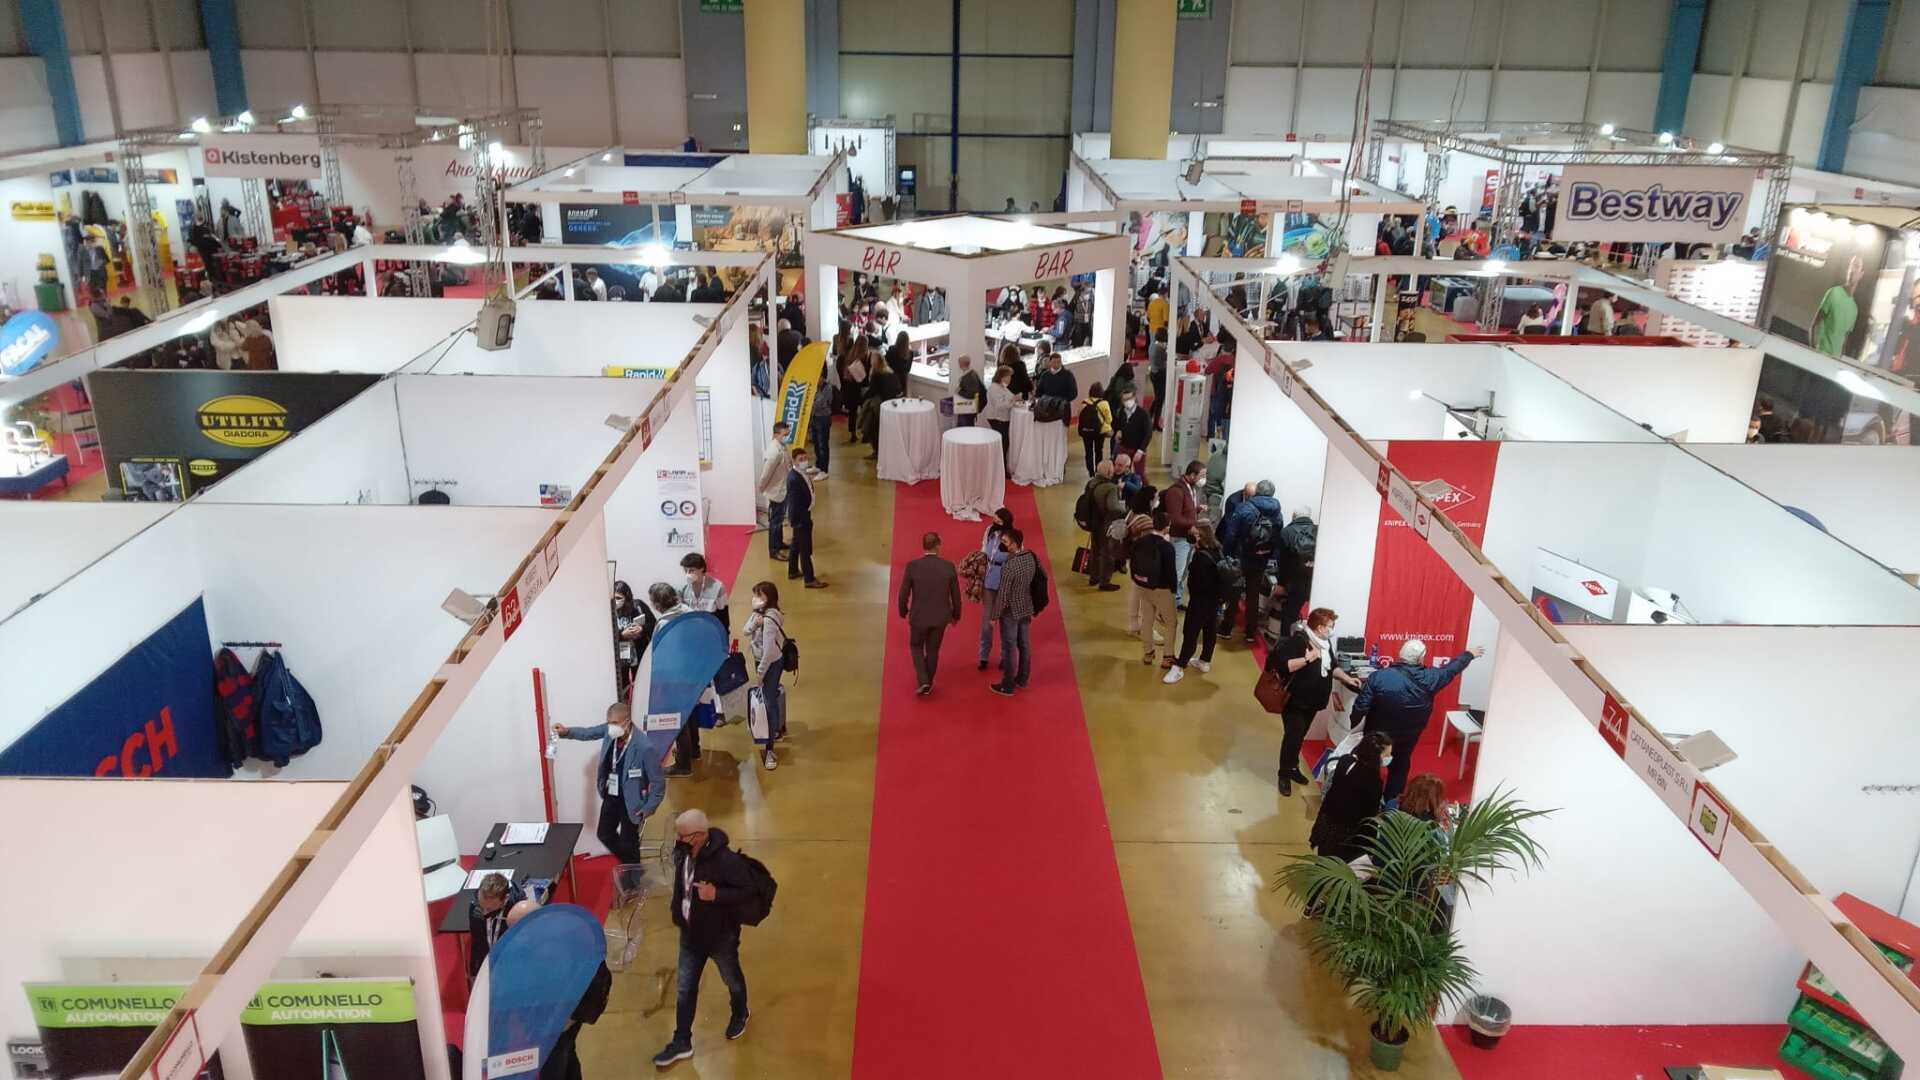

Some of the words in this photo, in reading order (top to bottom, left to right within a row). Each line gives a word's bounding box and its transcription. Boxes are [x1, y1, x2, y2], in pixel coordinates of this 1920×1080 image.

[222, 150, 321, 168] Kistenberg
[1569, 183, 1742, 229] Bestway
[862, 247, 901, 275] BAR
[1034, 248, 1074, 280] BAR
[625, 368, 656, 379] Rapid
[201, 415, 286, 428] UTILITY
[1380, 631, 1454, 642] www.knipex.com
[96, 705, 177, 778] CH
[62, 998, 176, 1011] COMUNELLO
[268, 994, 383, 1008] COMUNELLO
[271, 1008, 372, 1021] AUTOMATION
[505, 1054, 533, 1065] BOSCH
